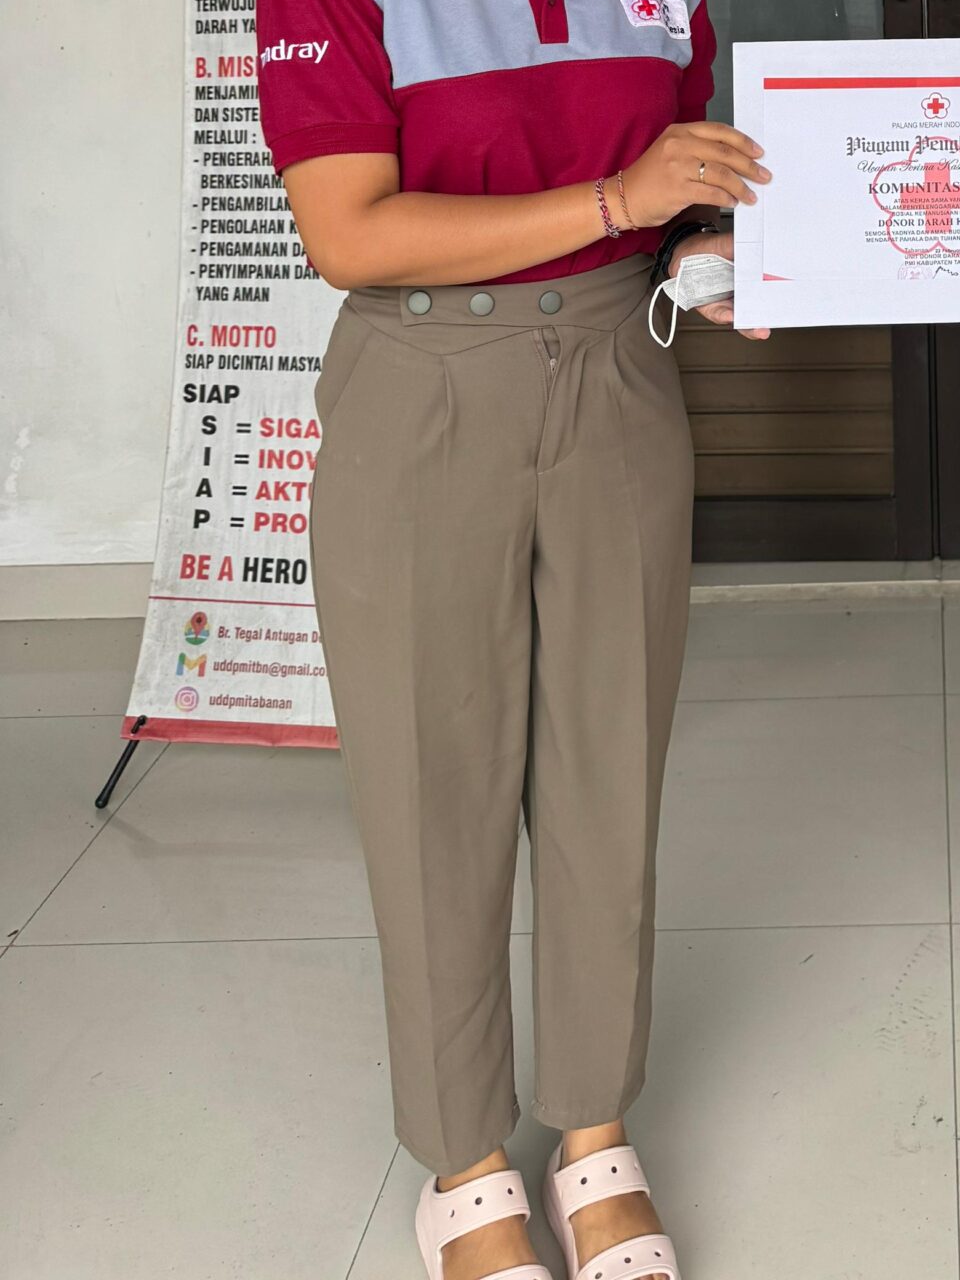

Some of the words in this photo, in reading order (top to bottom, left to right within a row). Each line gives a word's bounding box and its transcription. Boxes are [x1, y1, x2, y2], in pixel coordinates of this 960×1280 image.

[195, 19, 238, 34] DARAH
[195, 56, 212, 78] B.
[194, 107, 219, 122] DAN
[222, 107, 259, 122] SISTE
[892, 121, 918, 129] PALANG
[919, 121, 943, 129] MERAH
[194, 130, 248, 145] MELALUI
[846, 136, 909, 156] Piagam
[203, 151, 273, 167] PENGERAH
[201, 174, 286, 189] BERKESINAM
[868, 181, 960, 195] KOMUNITAS
[200, 219, 285, 234] PENGOLAHAN
[878, 218, 915, 227] DONOR
[917, 218, 953, 227] DARAH
[200, 242, 288, 257] PENGAMANAN
[199, 264, 291, 279] PENYIMPANAN
[196, 286, 229, 301] YANG
[233, 287, 270, 302] AMAN
[187, 324, 204, 347] C.
[211, 325, 277, 348] MOTTO
[185, 354, 214, 369] SIAP
[218, 354, 274, 371] DICINTAI
[183, 383, 240, 404] SIAP
[201, 415, 217, 435] S
[259, 417, 320, 439] SIGA
[203, 446, 211, 466] I
[195, 478, 213, 498] A
[193, 509, 211, 529] P
[253, 511, 307, 534] PRO
[180, 554, 211, 580] BE
[217, 555, 234, 581] A
[242, 556, 308, 585] HERO
[217, 626, 231, 639] Br.
[235, 626, 262, 642] Tegal
[264, 628, 308, 645] Antugan
[213, 659, 328, 678] uddpmitbn@gmail.co
[209, 694, 293, 709] uddpmitabanan
